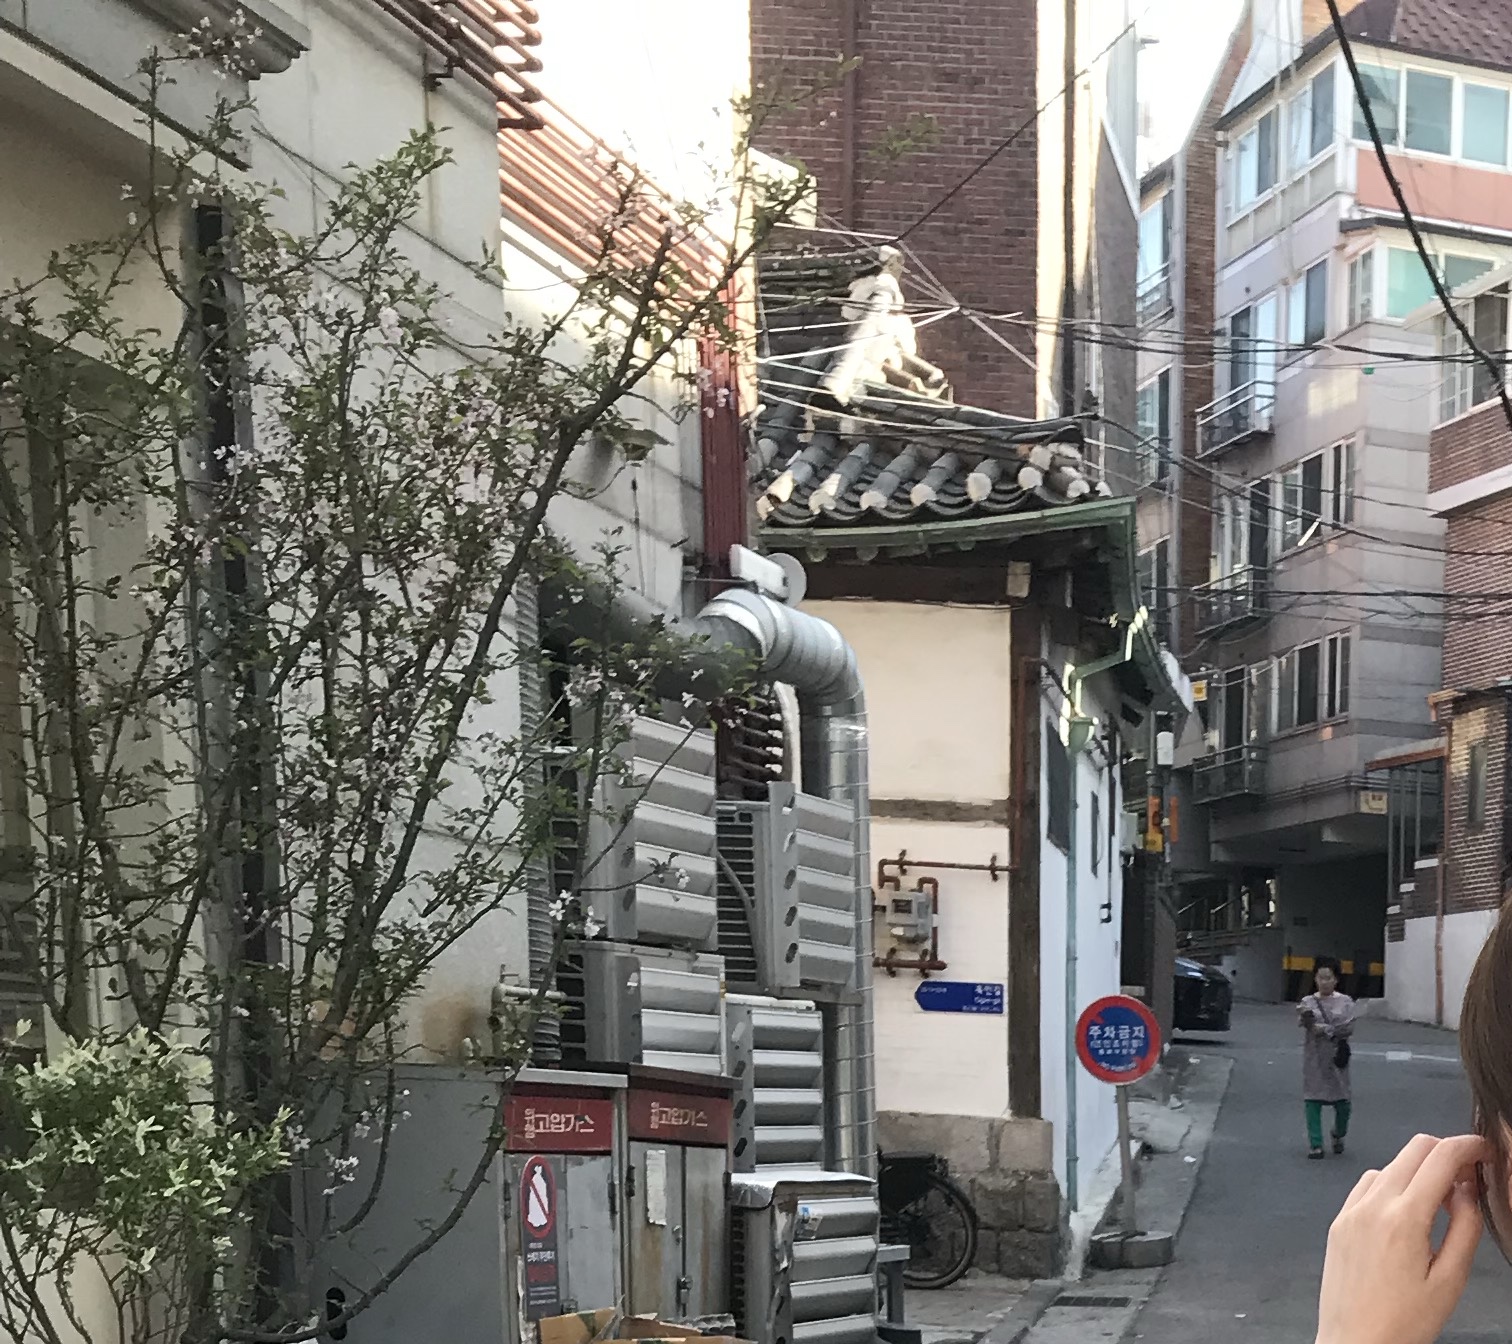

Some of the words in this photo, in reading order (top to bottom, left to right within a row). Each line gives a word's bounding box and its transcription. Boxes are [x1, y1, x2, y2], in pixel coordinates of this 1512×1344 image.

[1088, 1025, 1146, 1039] 주차금지
[535, 1113, 595, 1133] 고압가스
[659, 1107, 708, 1127] 고압가스
